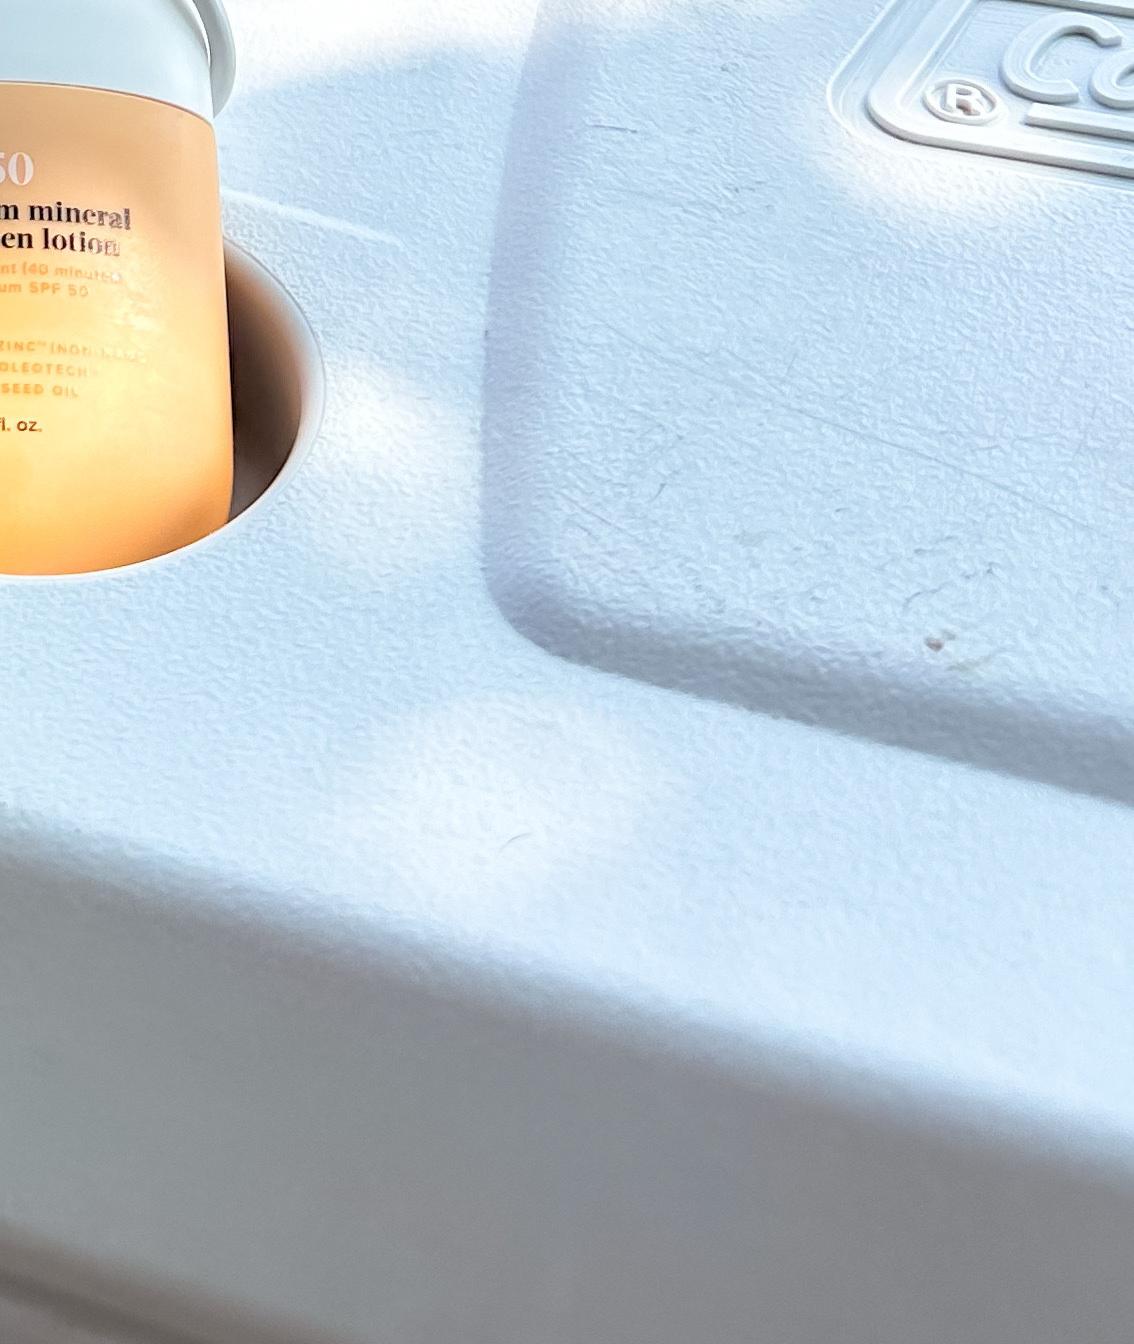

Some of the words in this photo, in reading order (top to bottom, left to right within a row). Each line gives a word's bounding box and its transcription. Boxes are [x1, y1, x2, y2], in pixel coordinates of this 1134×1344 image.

[29, 201, 131, 230] mineral
[22, 262, 49, 277] (40
[29, 282, 61, 295] SPF
[68, 284, 89, 297] 50
[1, 383, 44, 396] SEED
[52, 385, 79, 398] OIL
[17, 419, 43, 432] oz.
